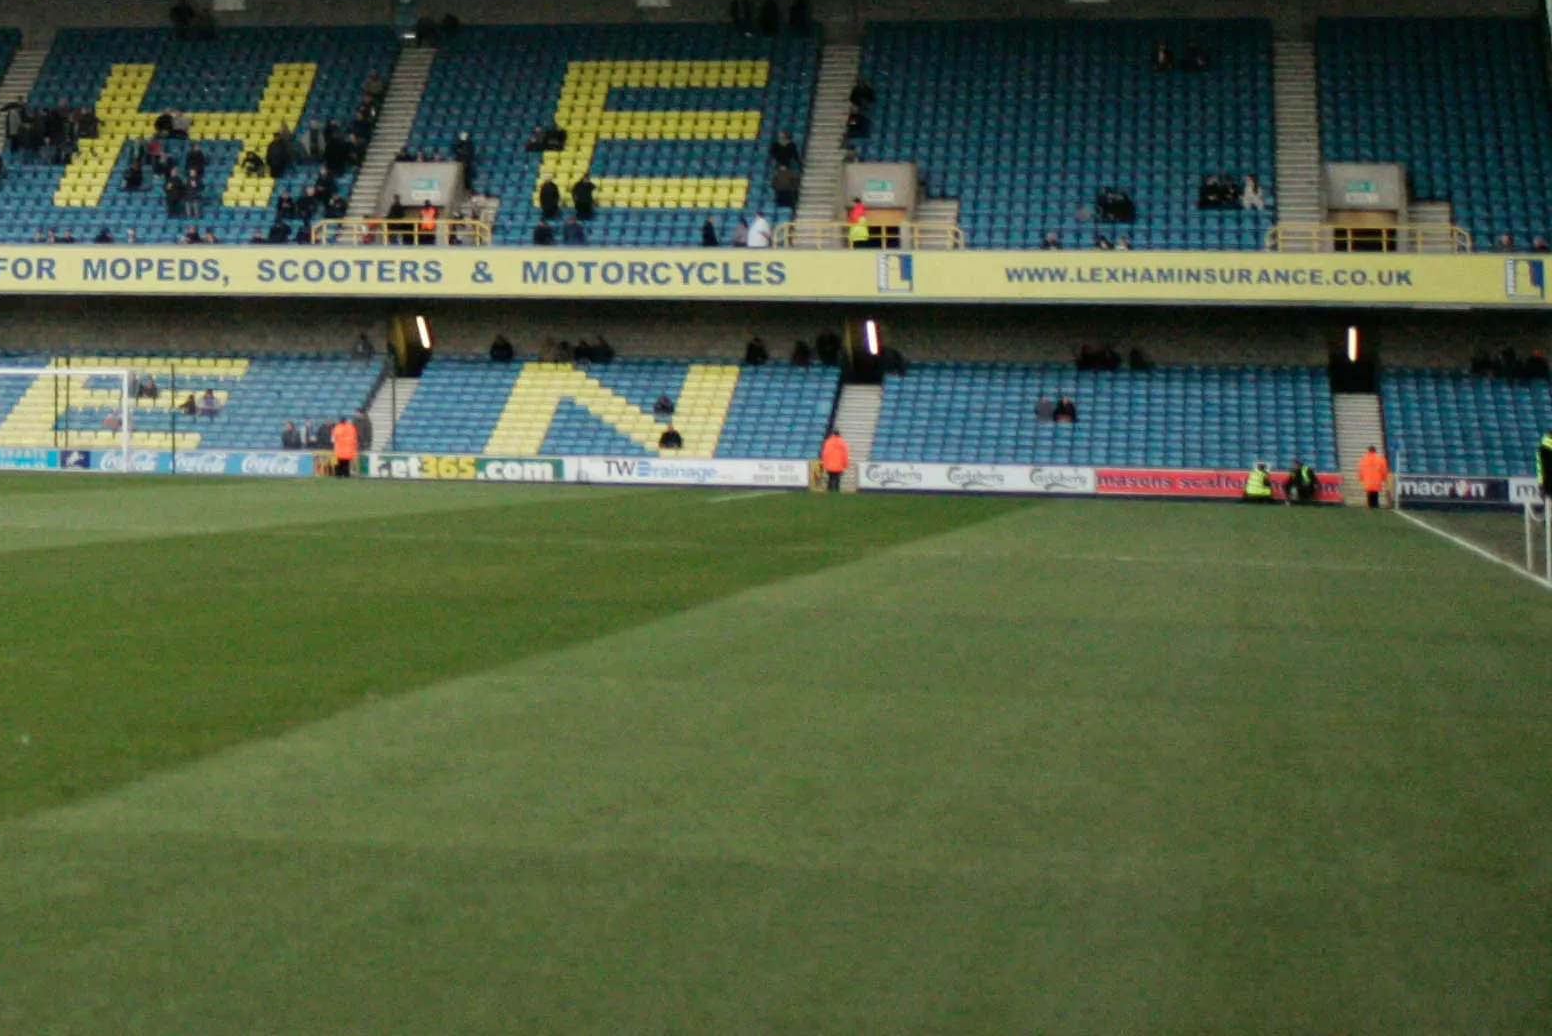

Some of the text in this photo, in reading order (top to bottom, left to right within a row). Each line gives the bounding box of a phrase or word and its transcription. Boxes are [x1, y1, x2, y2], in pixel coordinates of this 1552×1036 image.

[83, 258, 231, 287] MOPEDS,
[256, 258, 443, 283] SCOOTERS
[470, 260, 494, 284] &
[522, 260, 787, 286] MOTORCYCLES
[1004, 265, 1414, 288] WWW.LEXHAMINSURANCE.CO.UK
[368, 453, 555, 482] bet365.com
